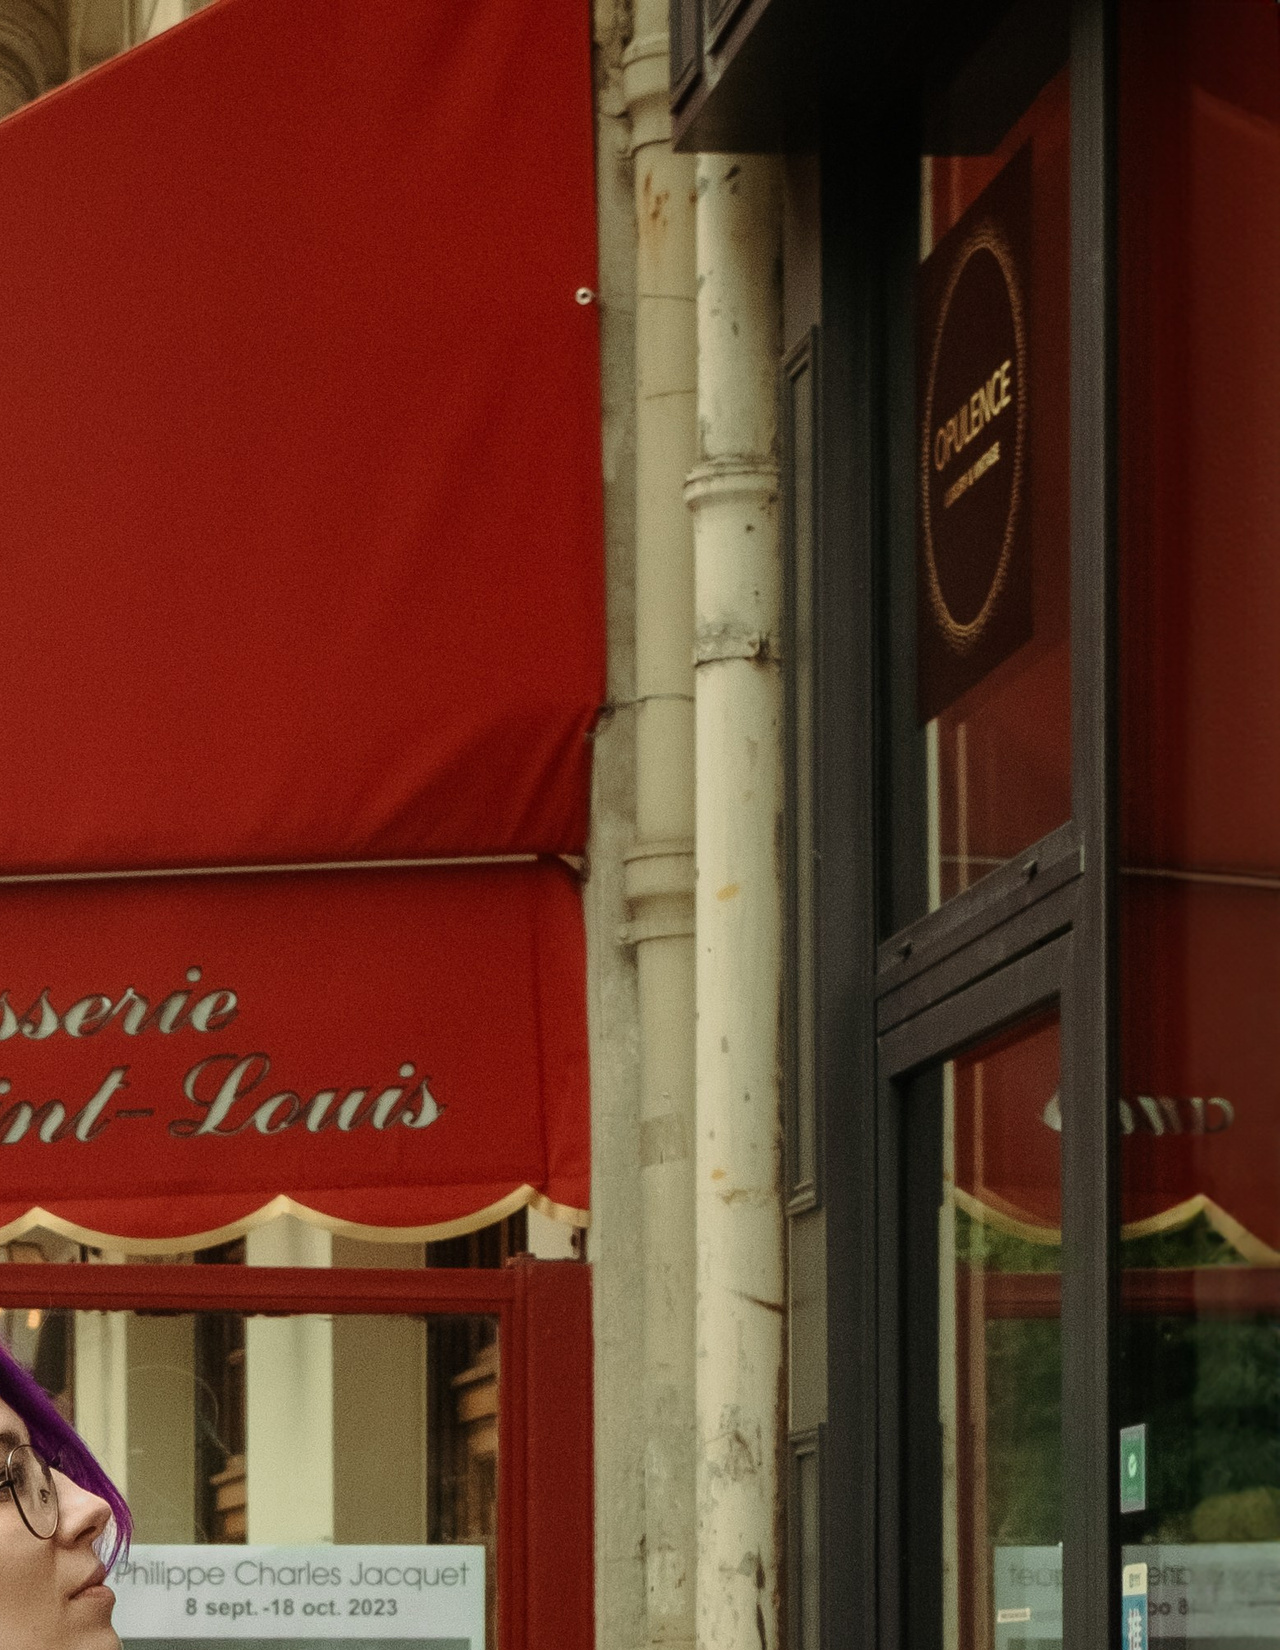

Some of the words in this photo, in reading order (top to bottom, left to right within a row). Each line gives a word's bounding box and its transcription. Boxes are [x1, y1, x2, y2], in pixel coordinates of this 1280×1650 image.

[934, 358, 1012, 472] OPULENCE
[115, 1560, 226, 1592] Philippe
[233, 1560, 342, 1588] Charles
[349, 1560, 470, 1592] Jacquet
[185, 1597, 198, 1617] 8
[301, 1600, 342, 1617] oct.
[348, 1598, 399, 1617] 2023
